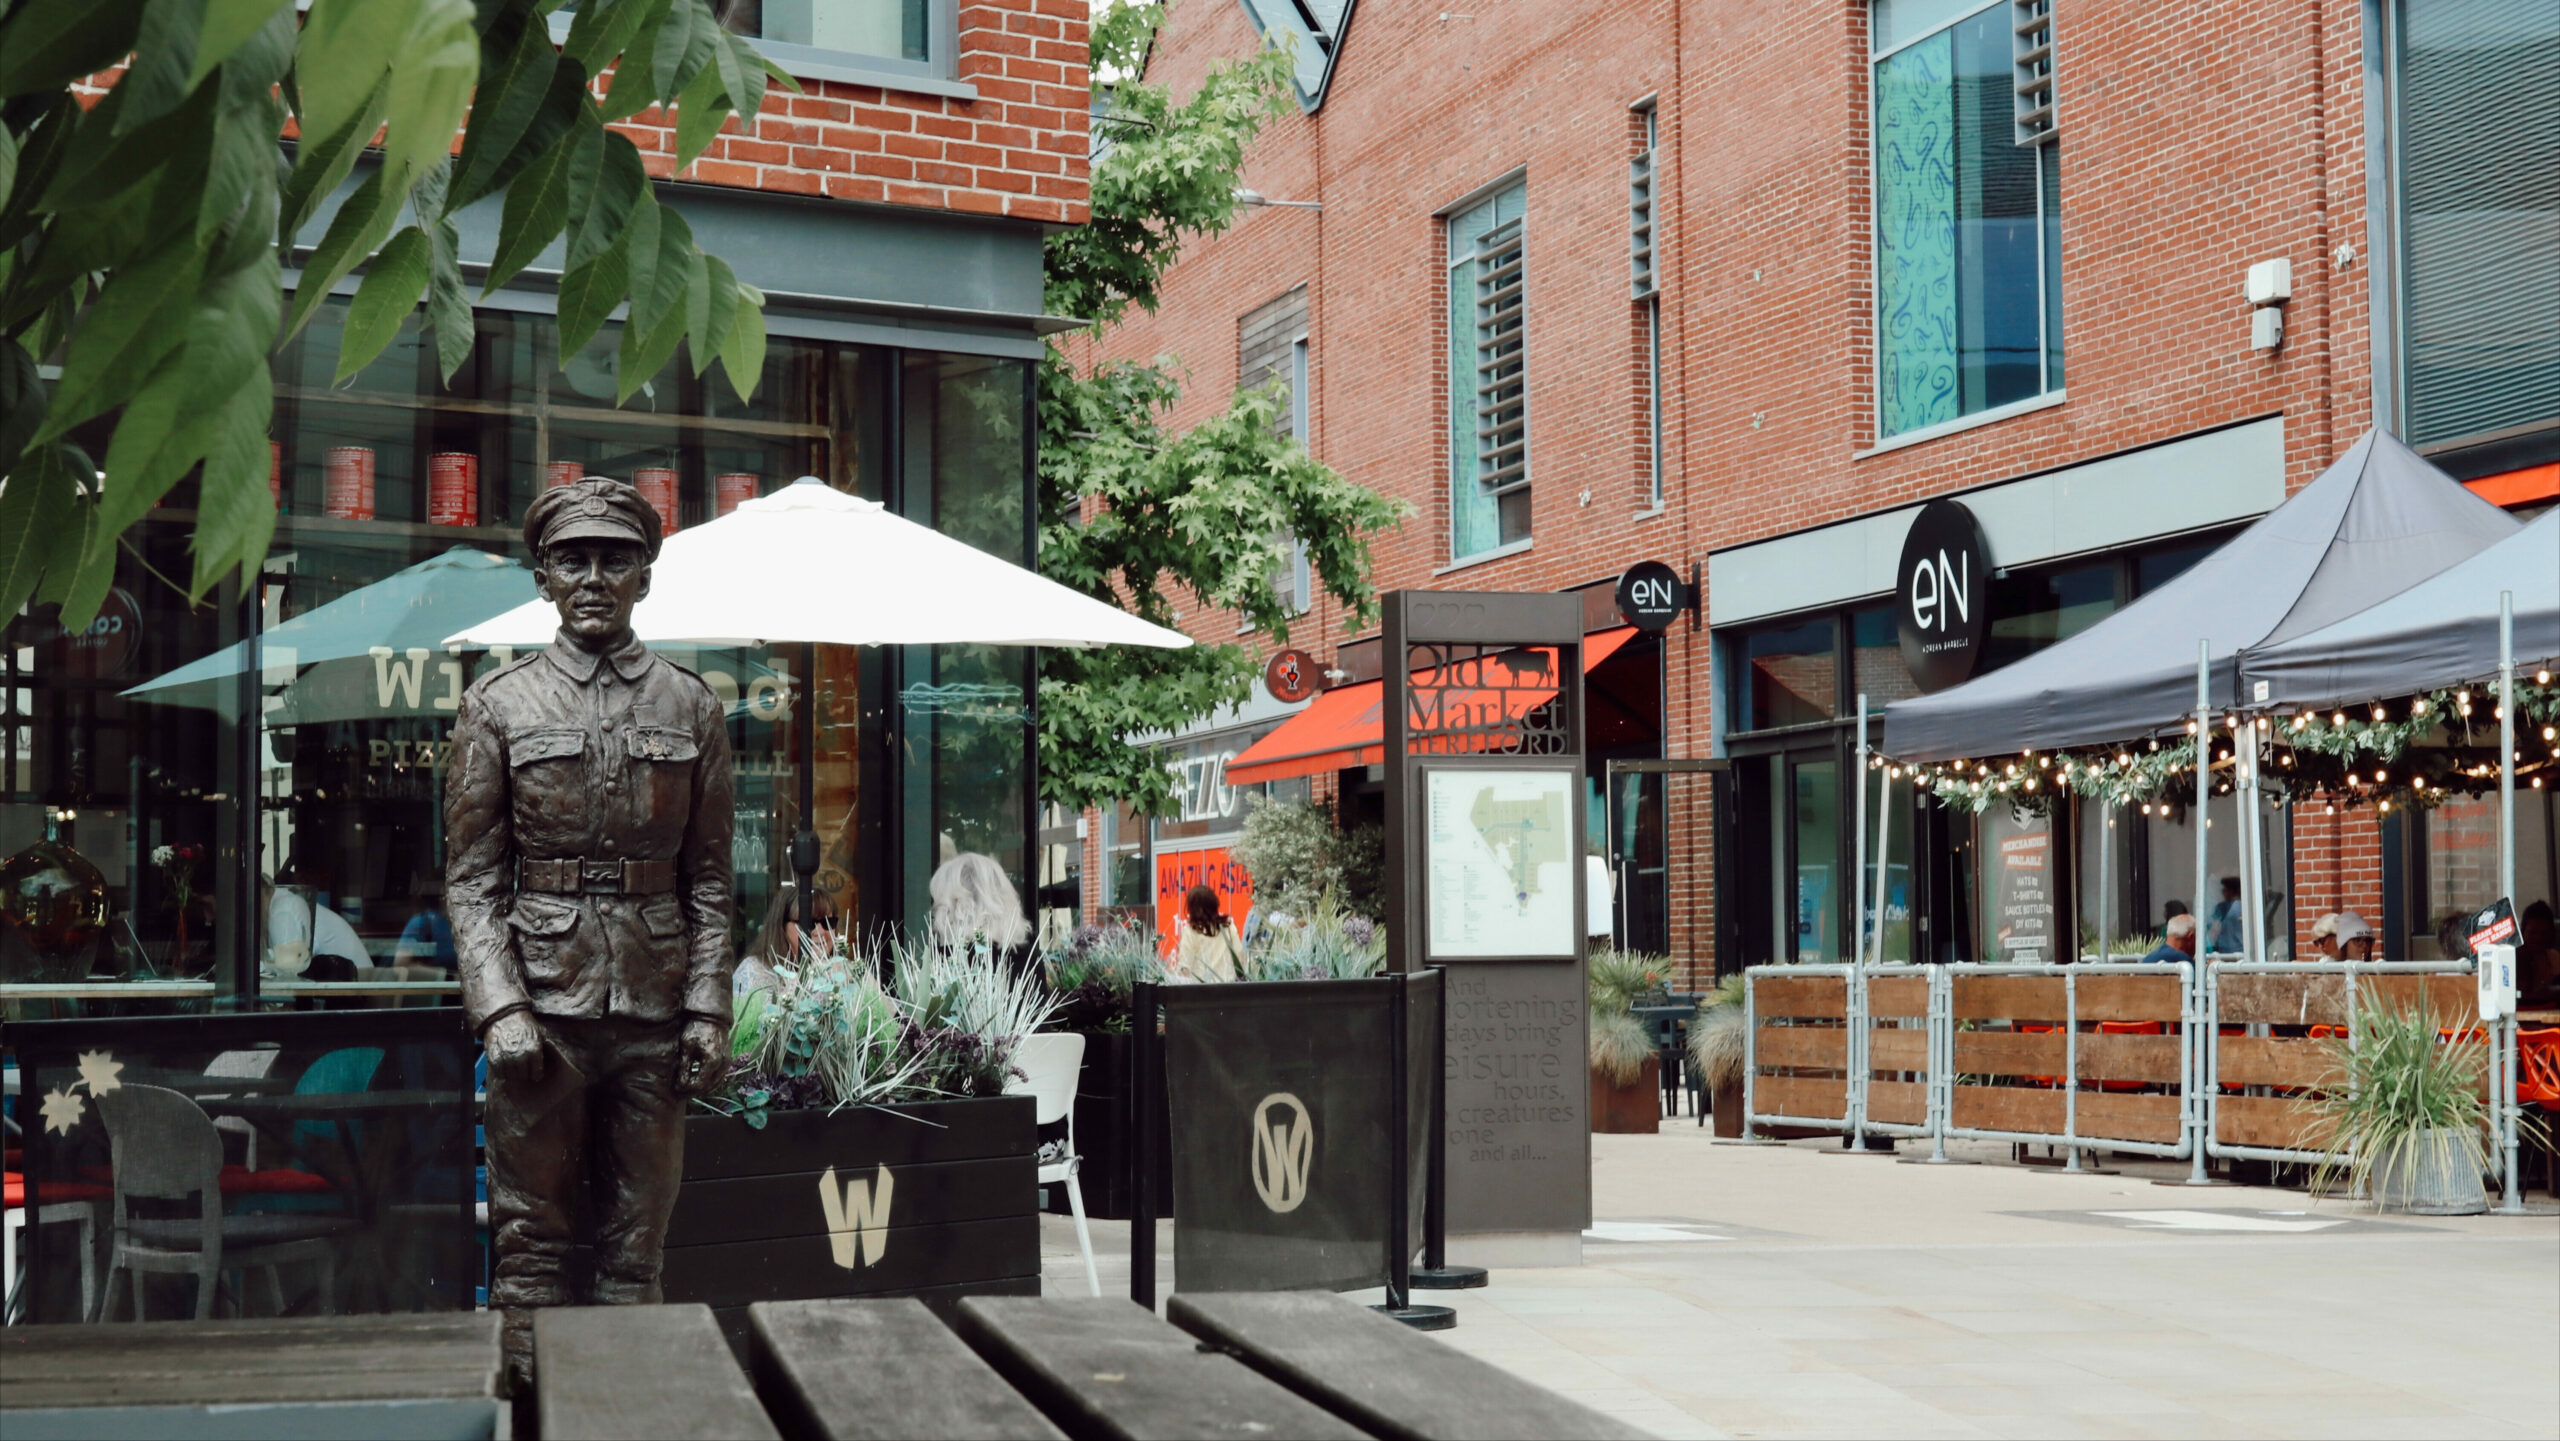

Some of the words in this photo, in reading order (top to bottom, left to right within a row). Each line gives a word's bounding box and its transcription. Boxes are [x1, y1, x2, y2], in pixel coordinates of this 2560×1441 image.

[1631, 577, 1672, 607] eN
[1912, 547, 1969, 633] eN
[1922, 643, 1942, 653] KOREAN
[1408, 644, 1483, 687] Old
[1408, 689, 1566, 730] Market
[1408, 733, 1566, 755] HEREFORD
[2007, 855, 2042, 866] AVAILABLE
[2016, 876, 2031, 887] HATS
[2005, 905, 2022, 916] SAUCE
[2023, 904, 2045, 915] BOTTLES
[2470, 928, 2492, 944] PLEASE
[1446, 995, 1577, 1026] ortening
[1504, 1023, 1561, 1047] bring
[1446, 1046, 1561, 1080] eisure
[1494, 1081, 1566, 1101] hours,
[1458, 1104, 1575, 1124] creatures
[1448, 1128, 1494, 1145] one
[1470, 1145, 1504, 1162] and
[818, 1161, 895, 1270] W
